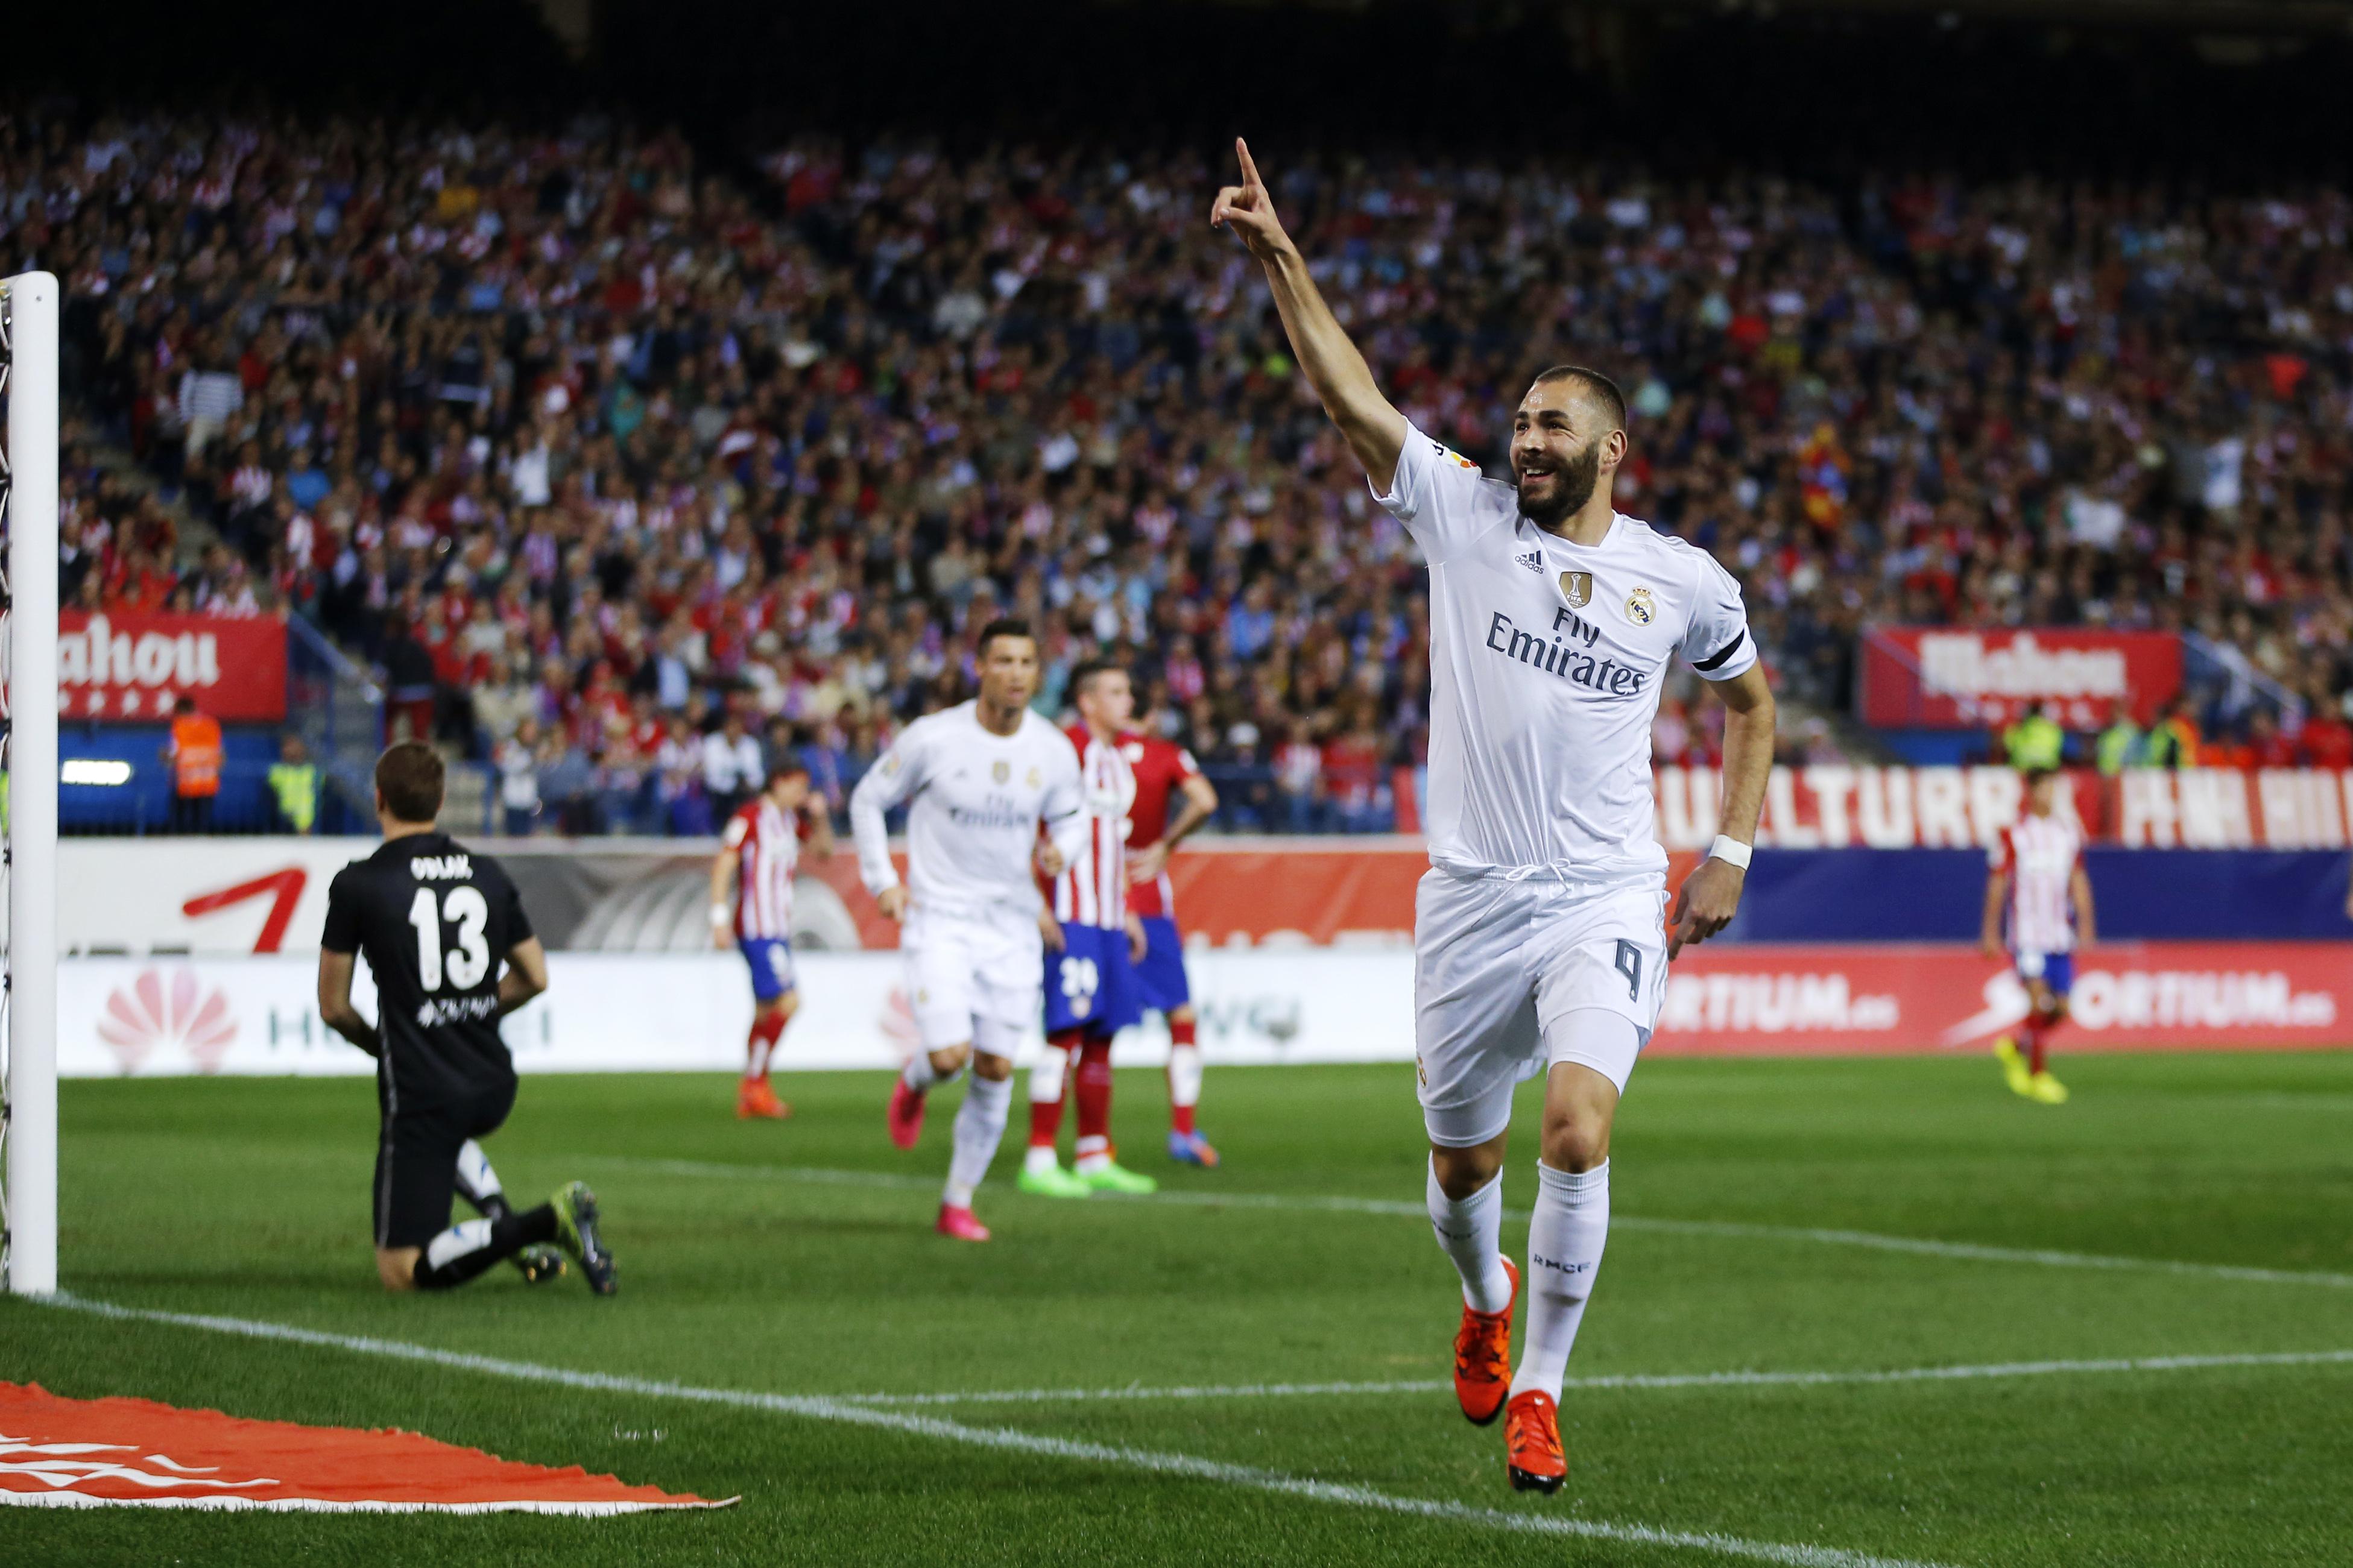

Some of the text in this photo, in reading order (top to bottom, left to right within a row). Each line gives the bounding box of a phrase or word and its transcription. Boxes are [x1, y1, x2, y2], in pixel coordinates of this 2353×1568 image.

[1514, 555, 1544, 575] adidas
[1567, 594, 1584, 602] FIFA
[58, 612, 221, 688] ahou
[1486, 611, 1646, 696] Emirates
[1552, 606, 1600, 649] Fly
[408, 886, 490, 992] 13
[1615, 939, 1643, 1004] 9
[1533, 1253, 1591, 1274] RMCF
